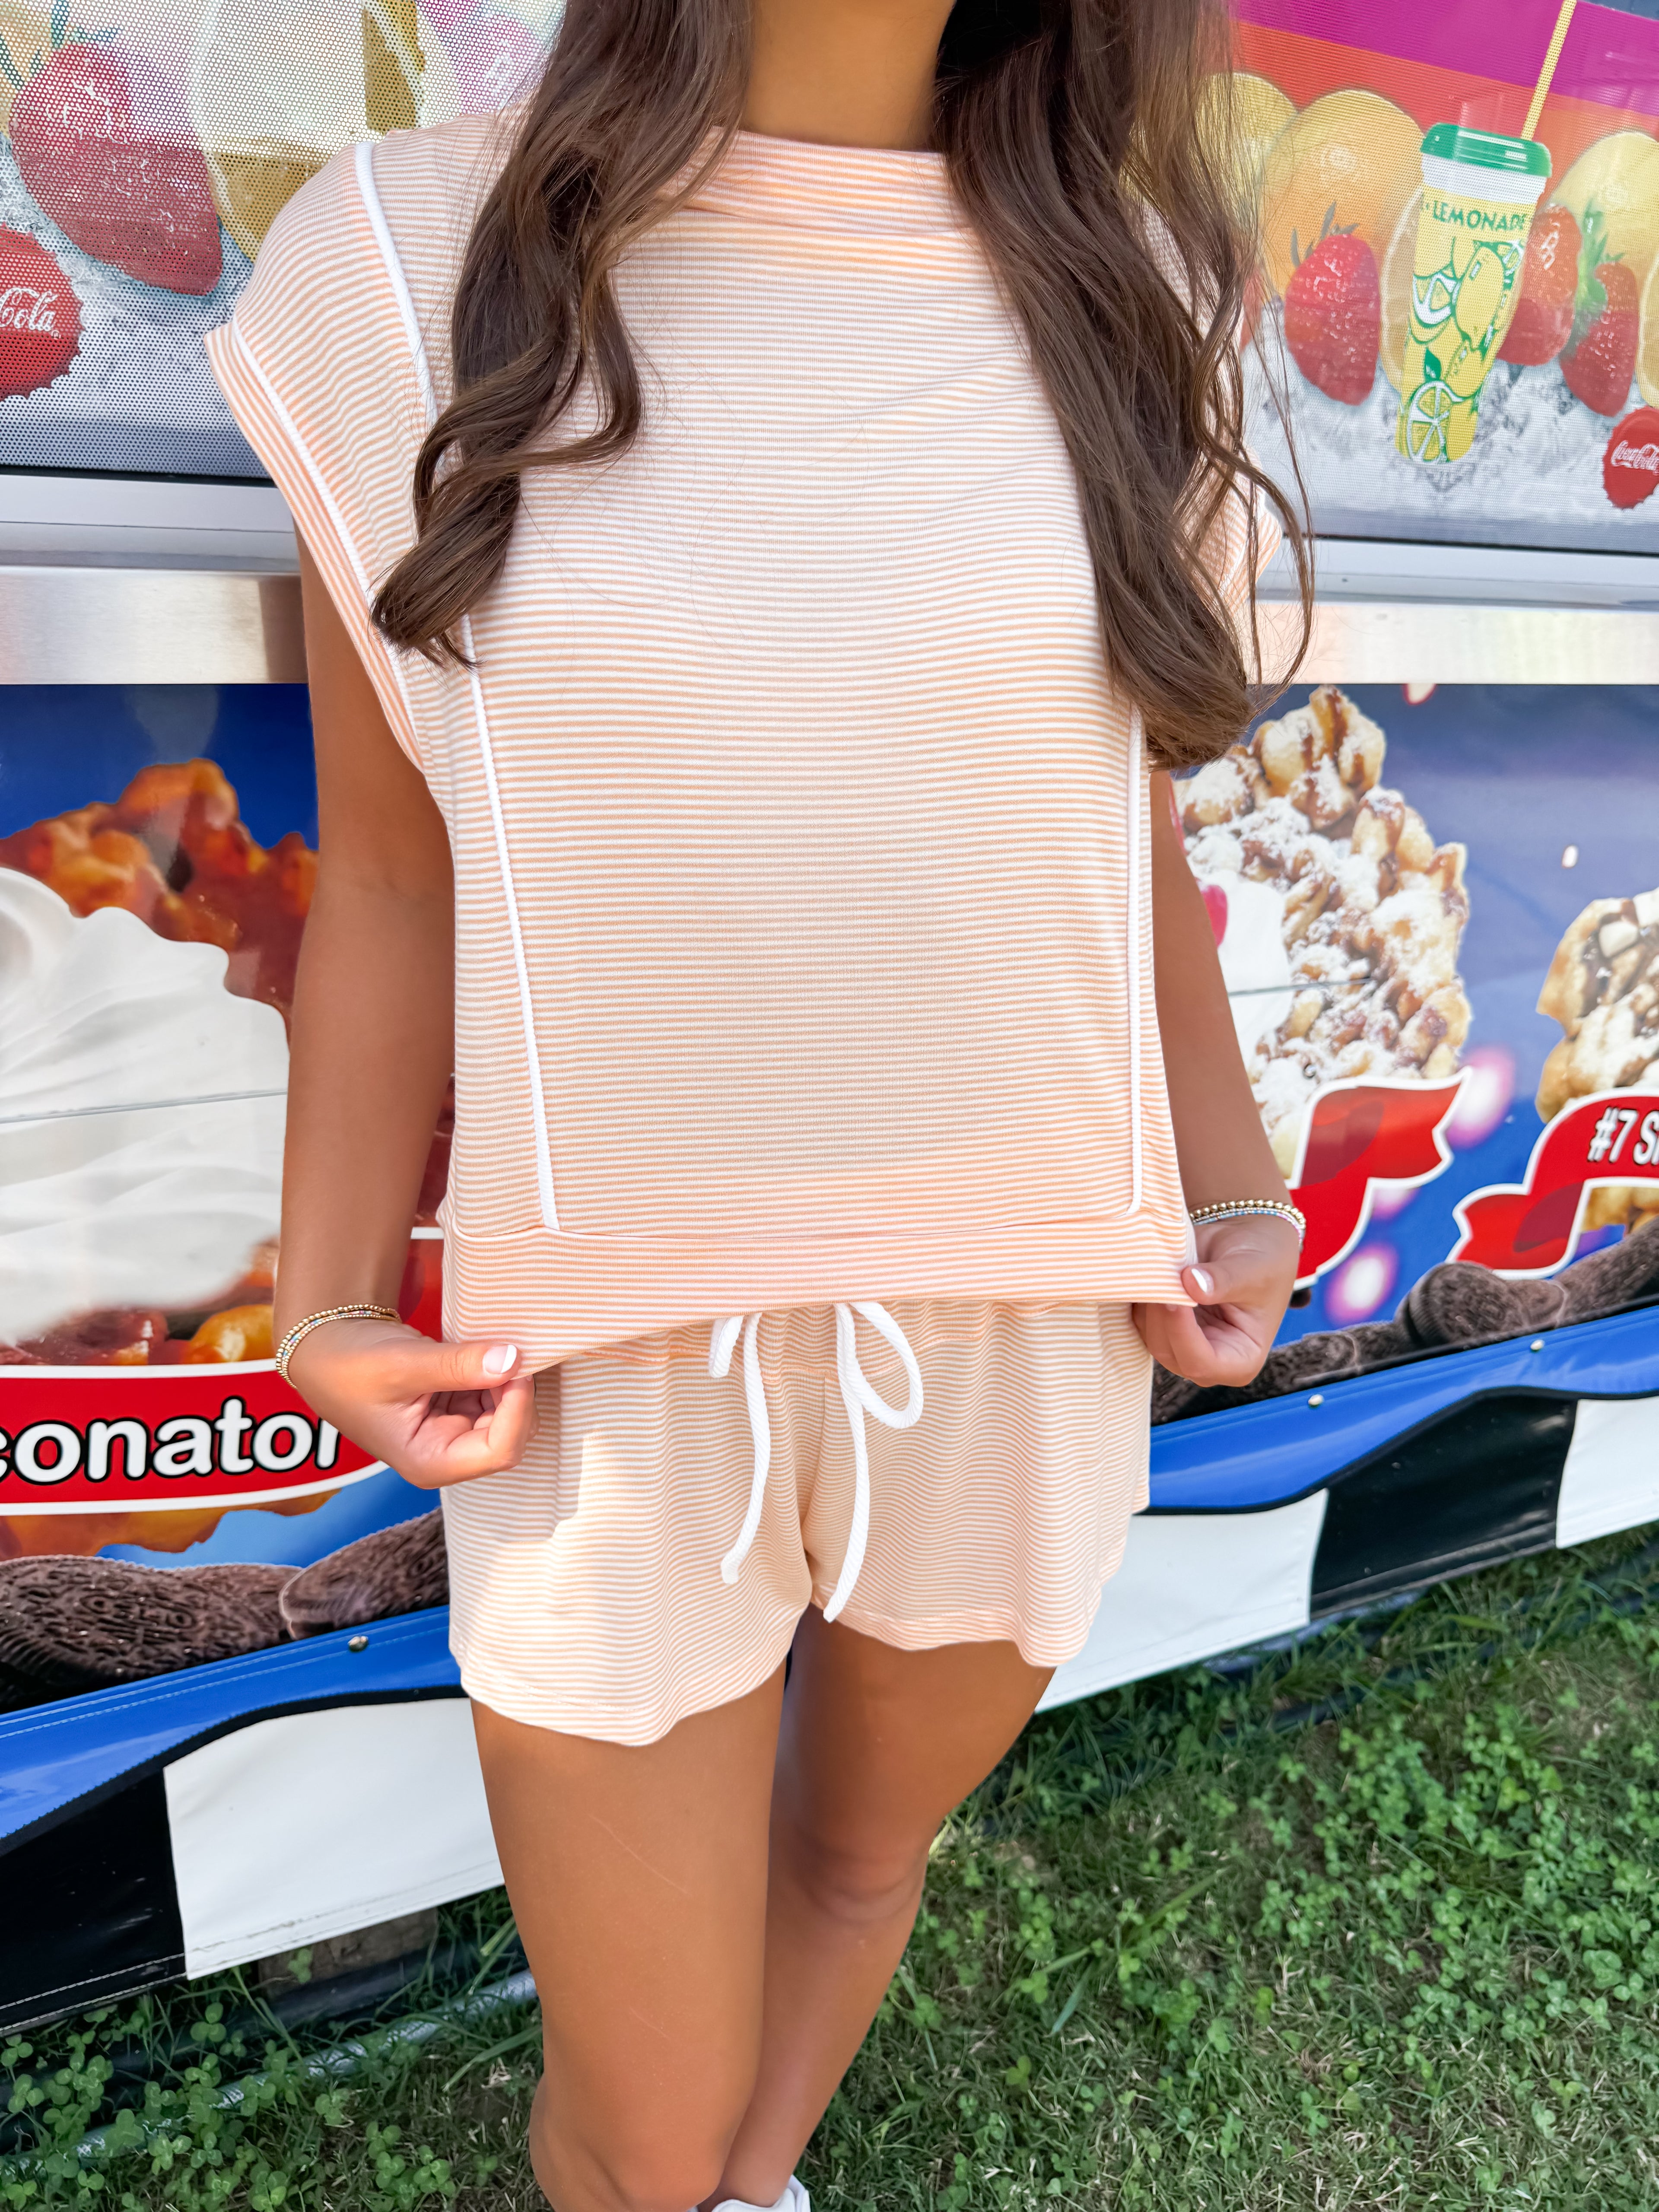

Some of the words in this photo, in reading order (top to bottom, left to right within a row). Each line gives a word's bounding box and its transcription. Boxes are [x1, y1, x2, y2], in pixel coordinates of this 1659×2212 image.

[1587, 1105, 1639, 1163] #7
[1633, 1109, 1659, 1166] S
[0, 1396, 341, 1486] onator
